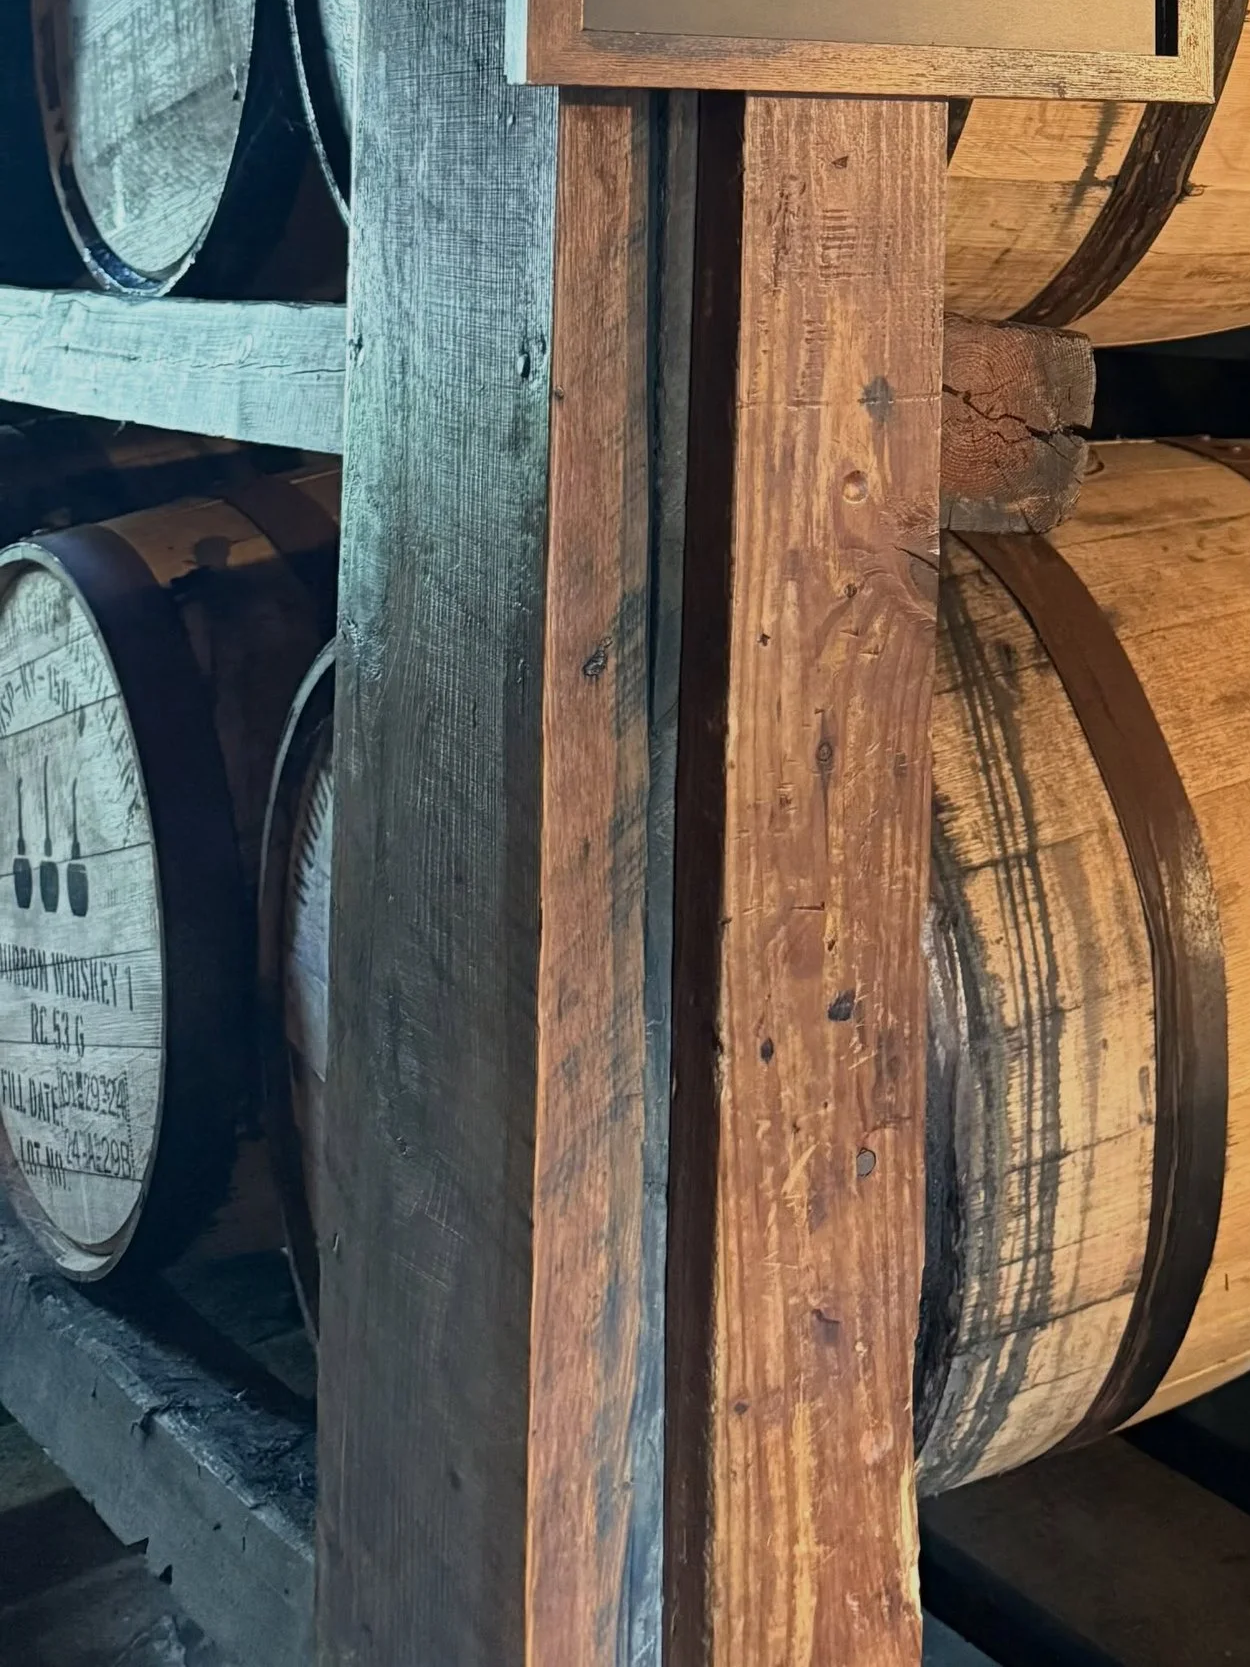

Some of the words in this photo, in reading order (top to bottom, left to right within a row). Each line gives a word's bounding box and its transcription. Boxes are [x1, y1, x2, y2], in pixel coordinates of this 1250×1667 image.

[51, 951, 118, 1008] WHISKEY
[30, 1002, 48, 1044] RC
[53, 1007, 70, 1053] 53
[1, 1068, 26, 1114] FILL
[20, 1136, 43, 1177] LOT
